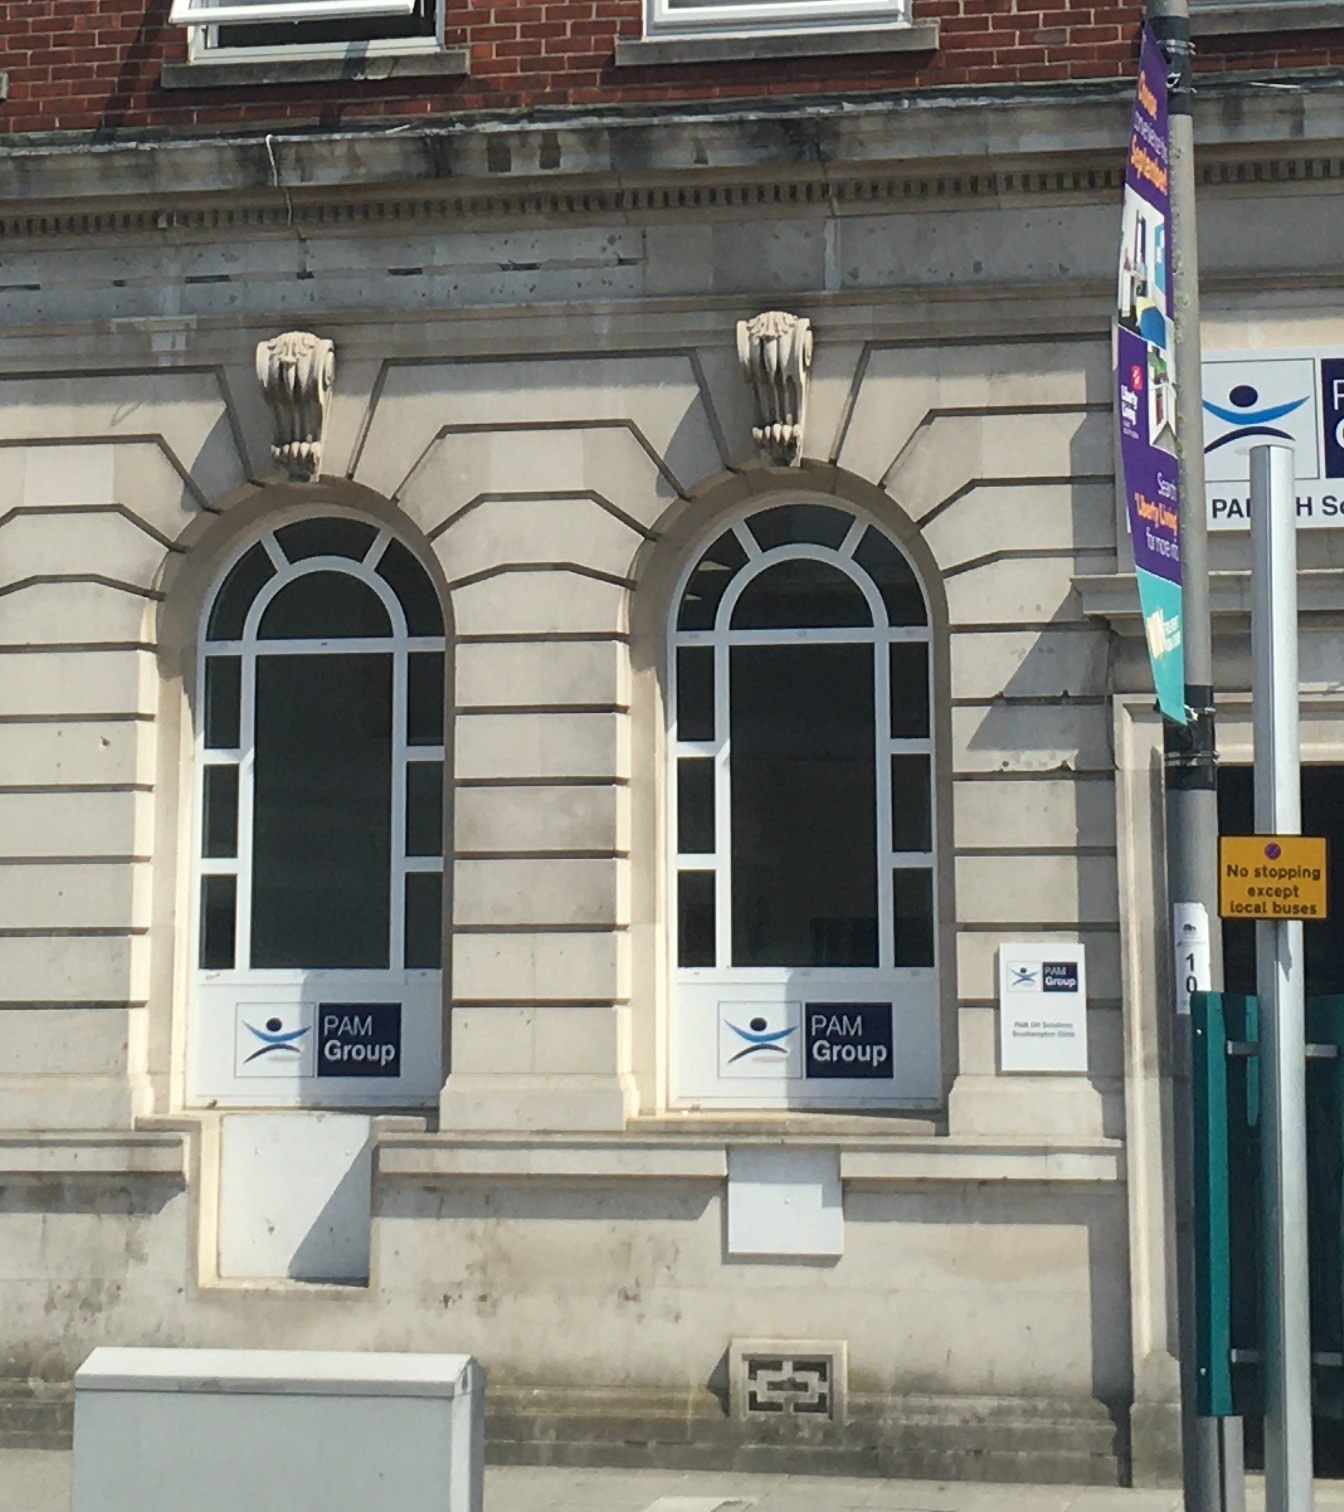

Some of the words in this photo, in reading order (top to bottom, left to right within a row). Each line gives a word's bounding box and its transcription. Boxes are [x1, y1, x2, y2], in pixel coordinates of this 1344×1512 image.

[1212, 498, 1250, 519] PA
[1227, 864, 1249, 878] No
[1254, 865, 1321, 881] stopping
[1247, 885, 1300, 899] except
[1230, 900, 1267, 914] local
[1272, 901, 1318, 915] buses
[1044, 966, 1067, 976] PAM
[1045, 976, 1076, 988] Group
[323, 1015, 373, 1036] PAM
[811, 1014, 863, 1036] PAM
[324, 1039, 396, 1066] Group
[812, 1039, 888, 1066] Group
